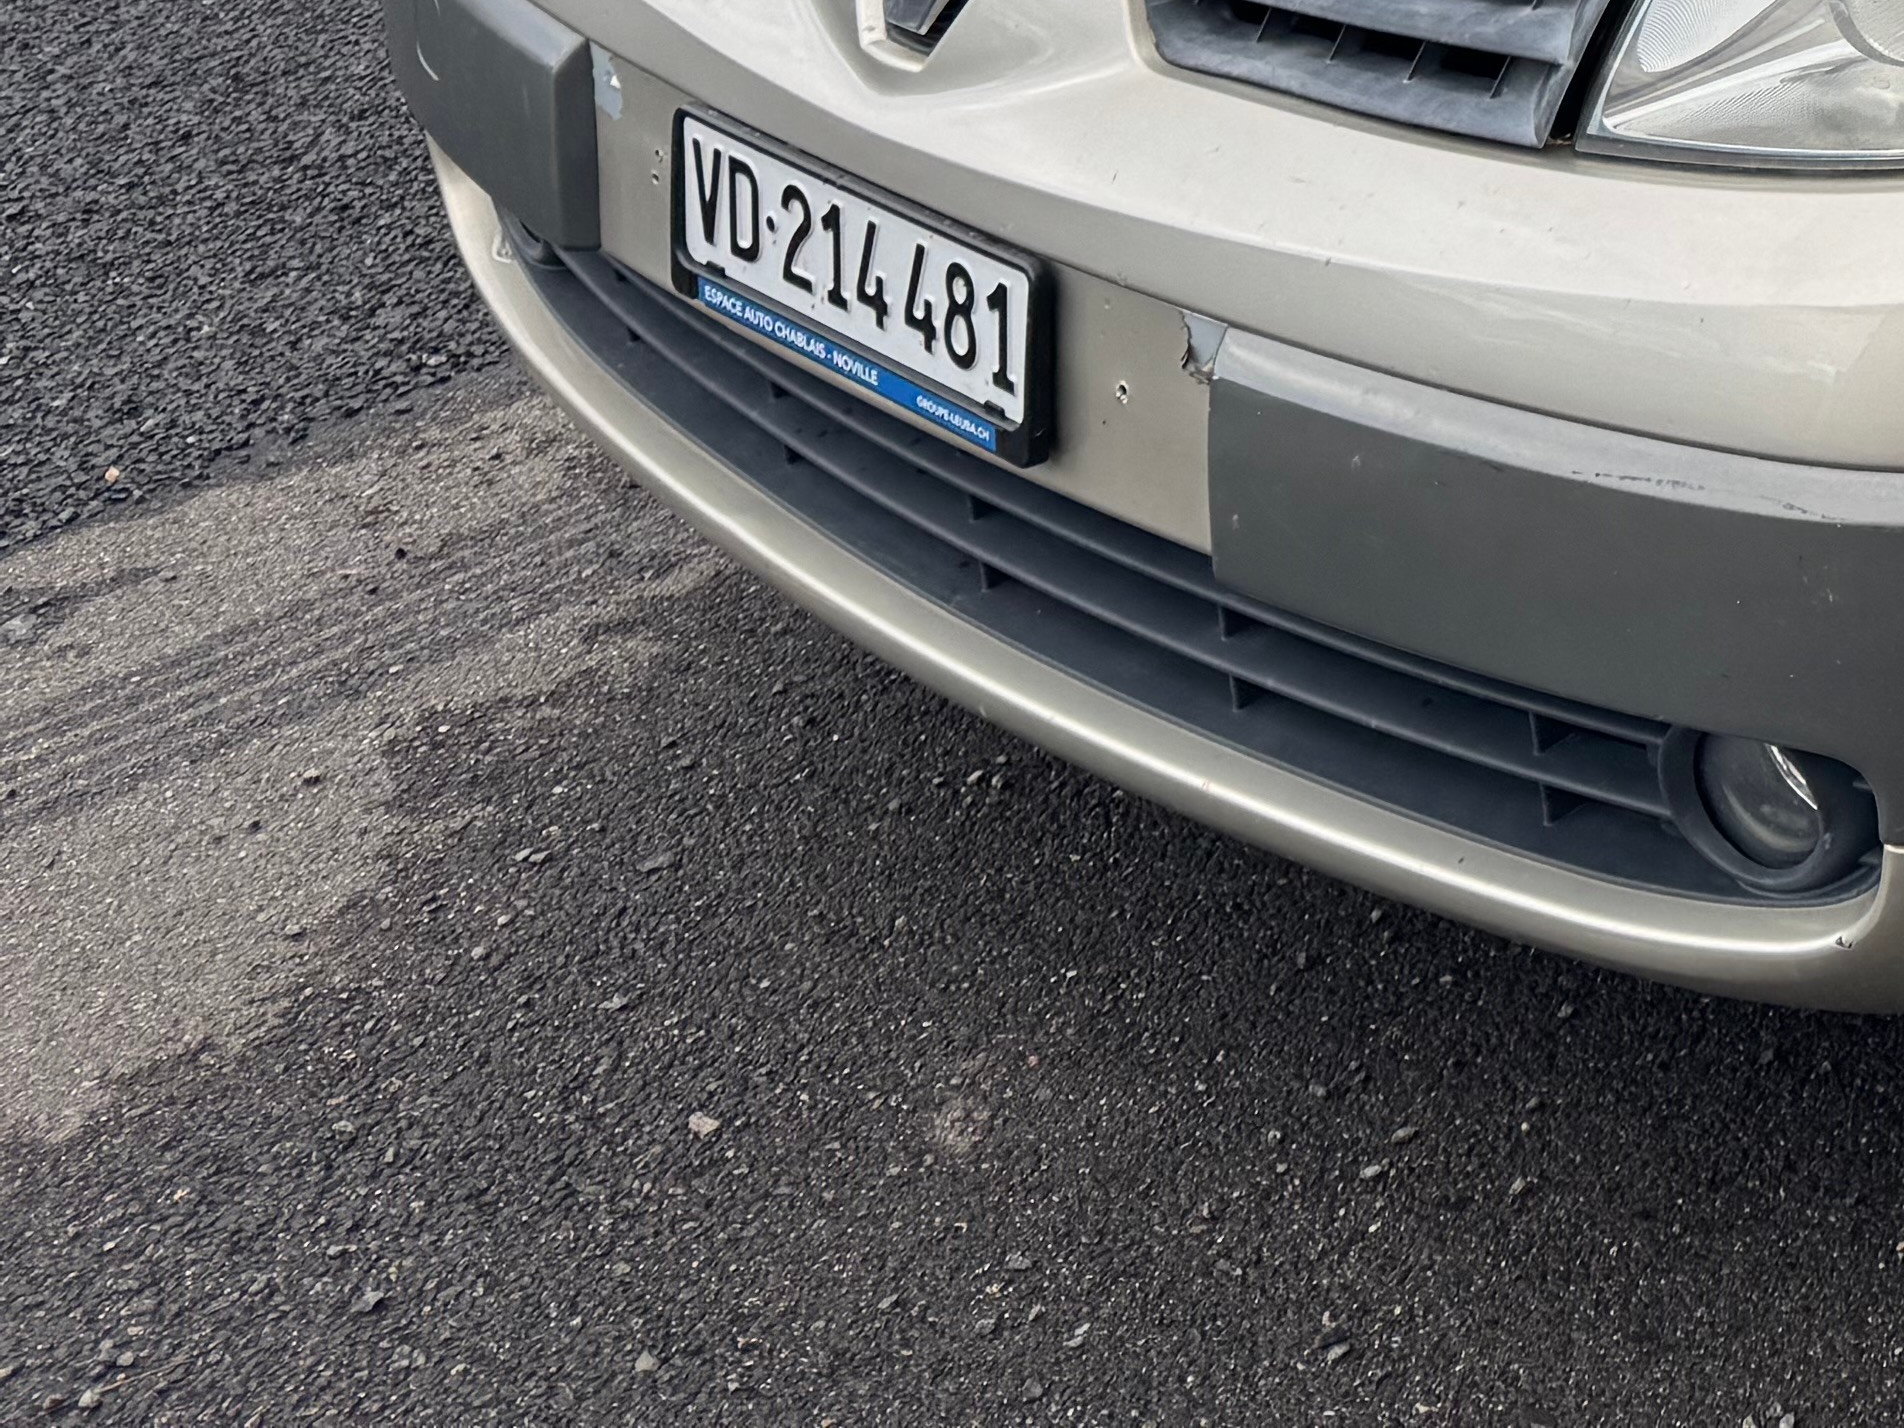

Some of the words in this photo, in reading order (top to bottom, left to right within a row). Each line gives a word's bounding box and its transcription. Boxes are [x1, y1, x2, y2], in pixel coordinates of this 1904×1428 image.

[703, 285, 743, 317] ESPACE
[744, 305, 773, 332] AUTO
[774, 320, 827, 359] CHABLAIS
[833, 349, 879, 386] NOVILLE
